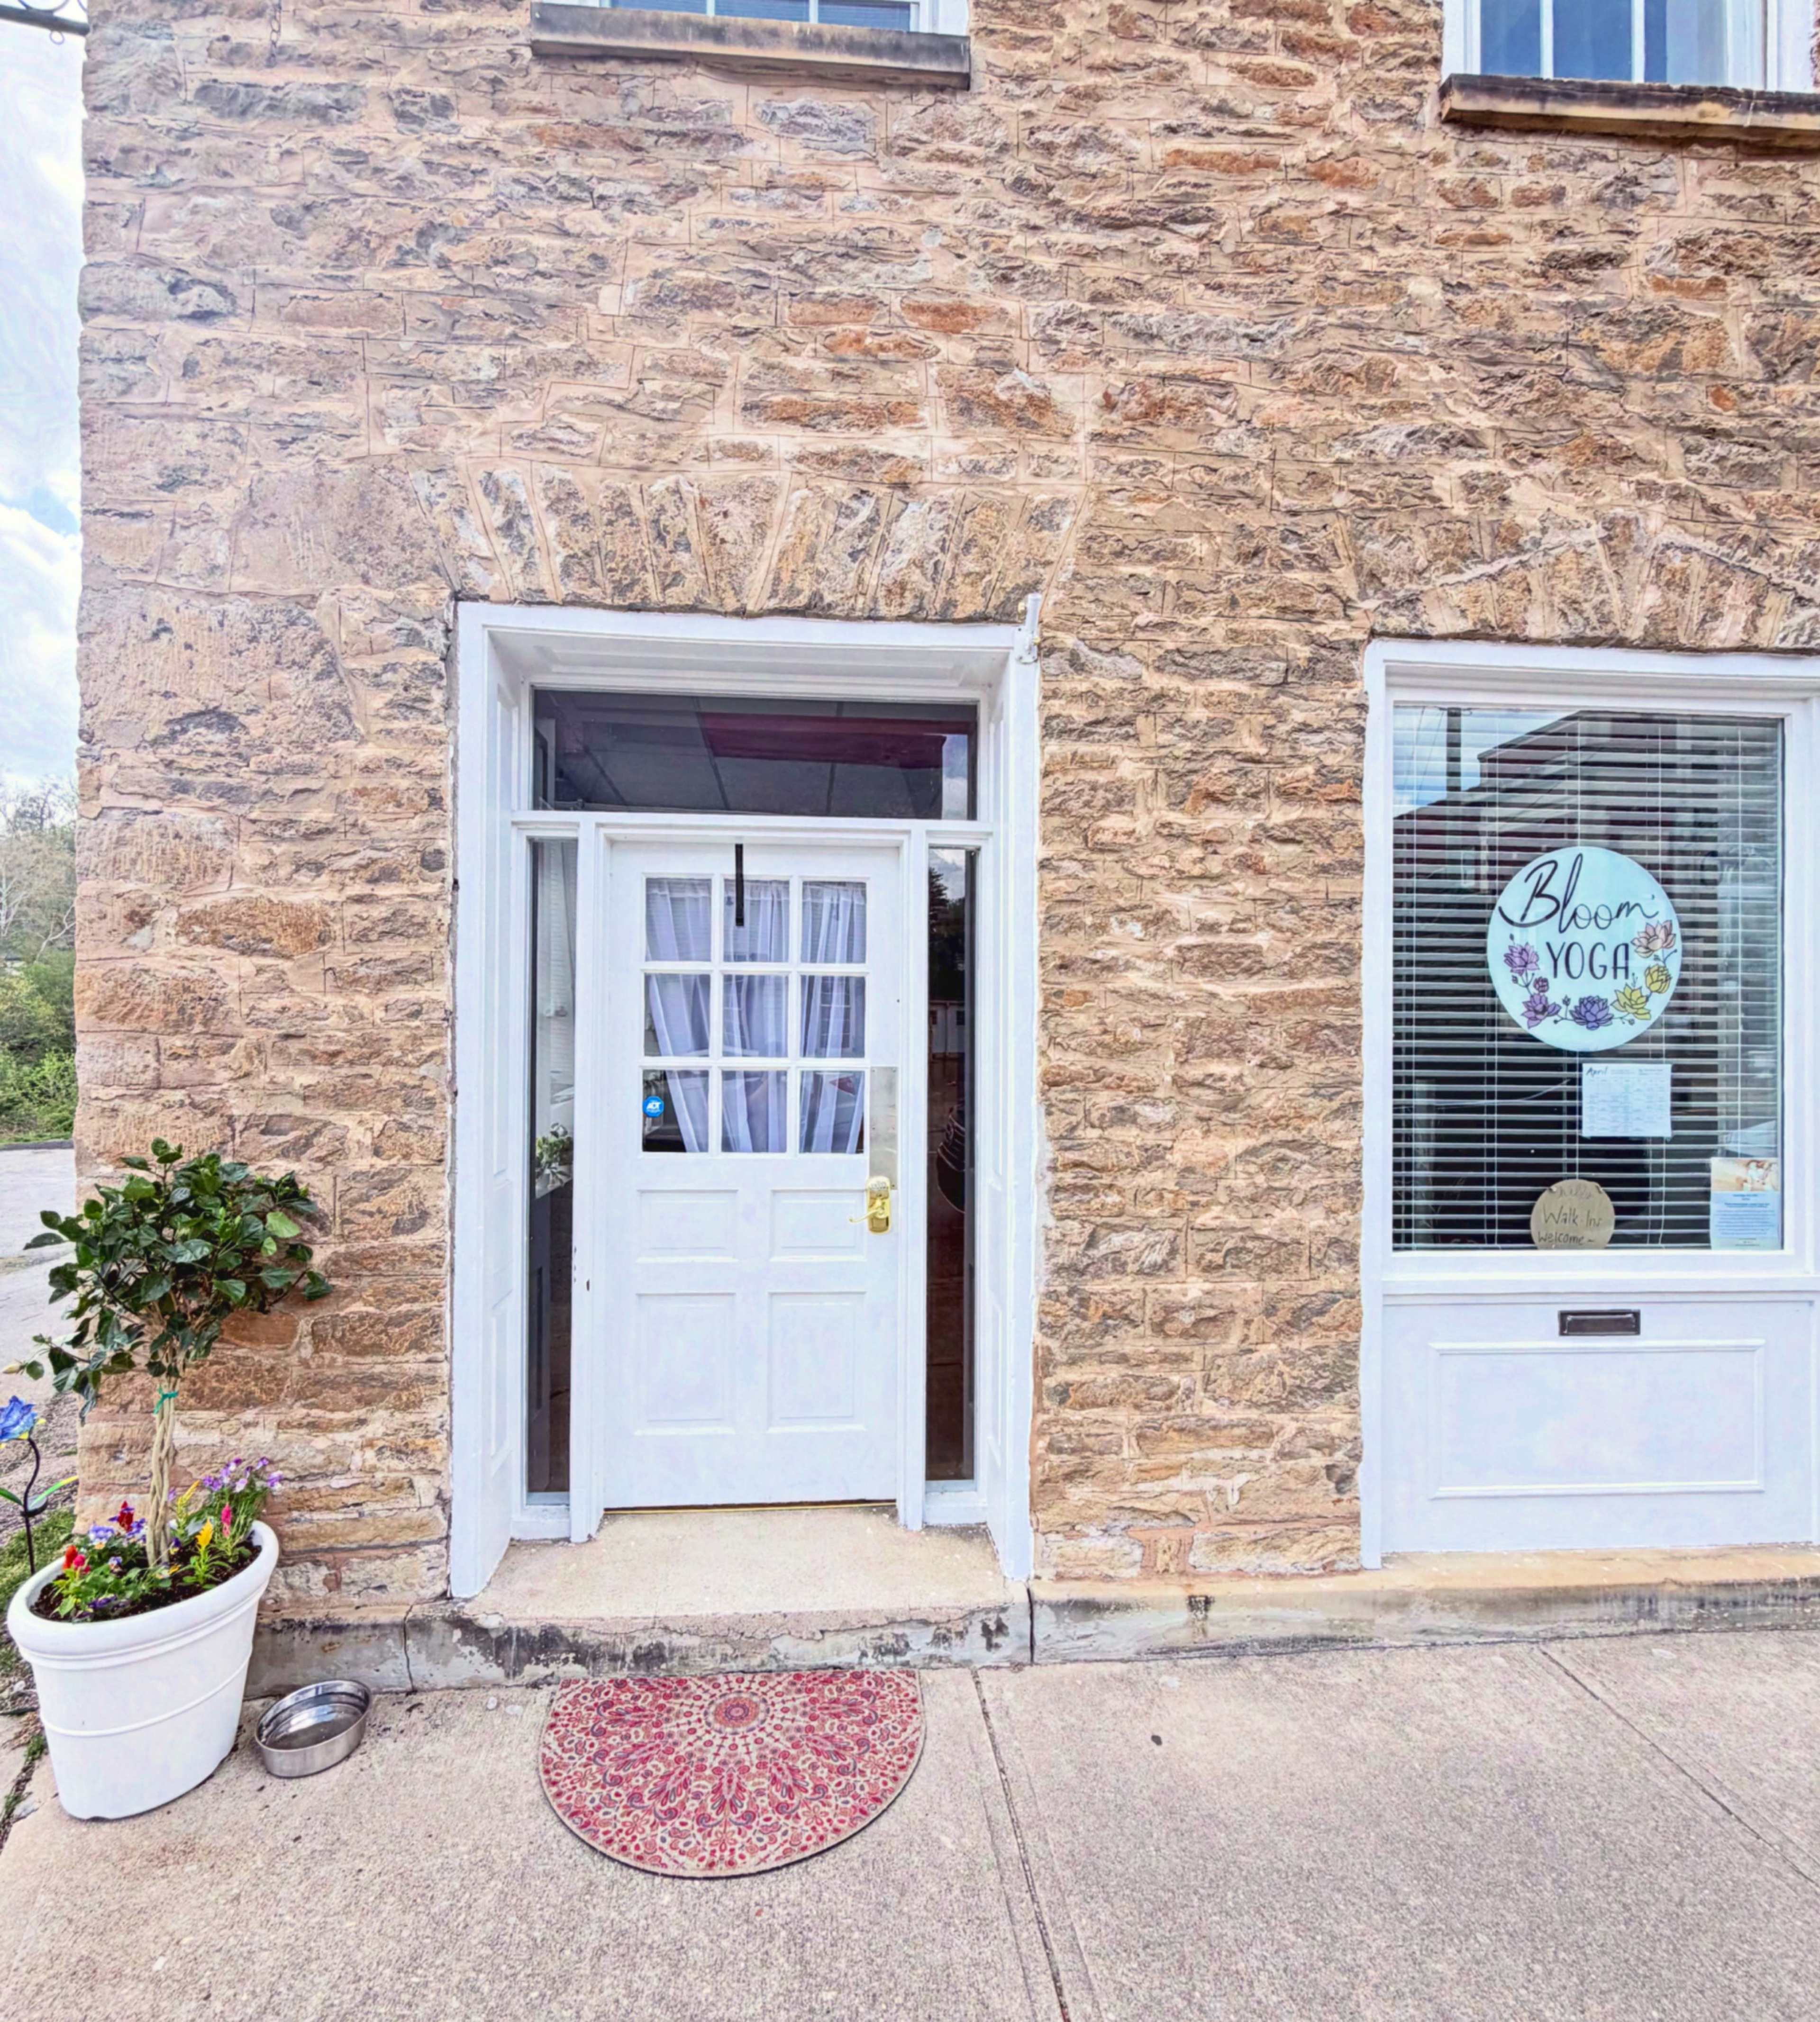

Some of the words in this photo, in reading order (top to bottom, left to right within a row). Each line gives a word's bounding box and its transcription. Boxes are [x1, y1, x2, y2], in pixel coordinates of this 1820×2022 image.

[1498, 853, 1659, 934] Bloom
[1546, 941, 1629, 979] YOGA
[1586, 1066, 1608, 1077] April
